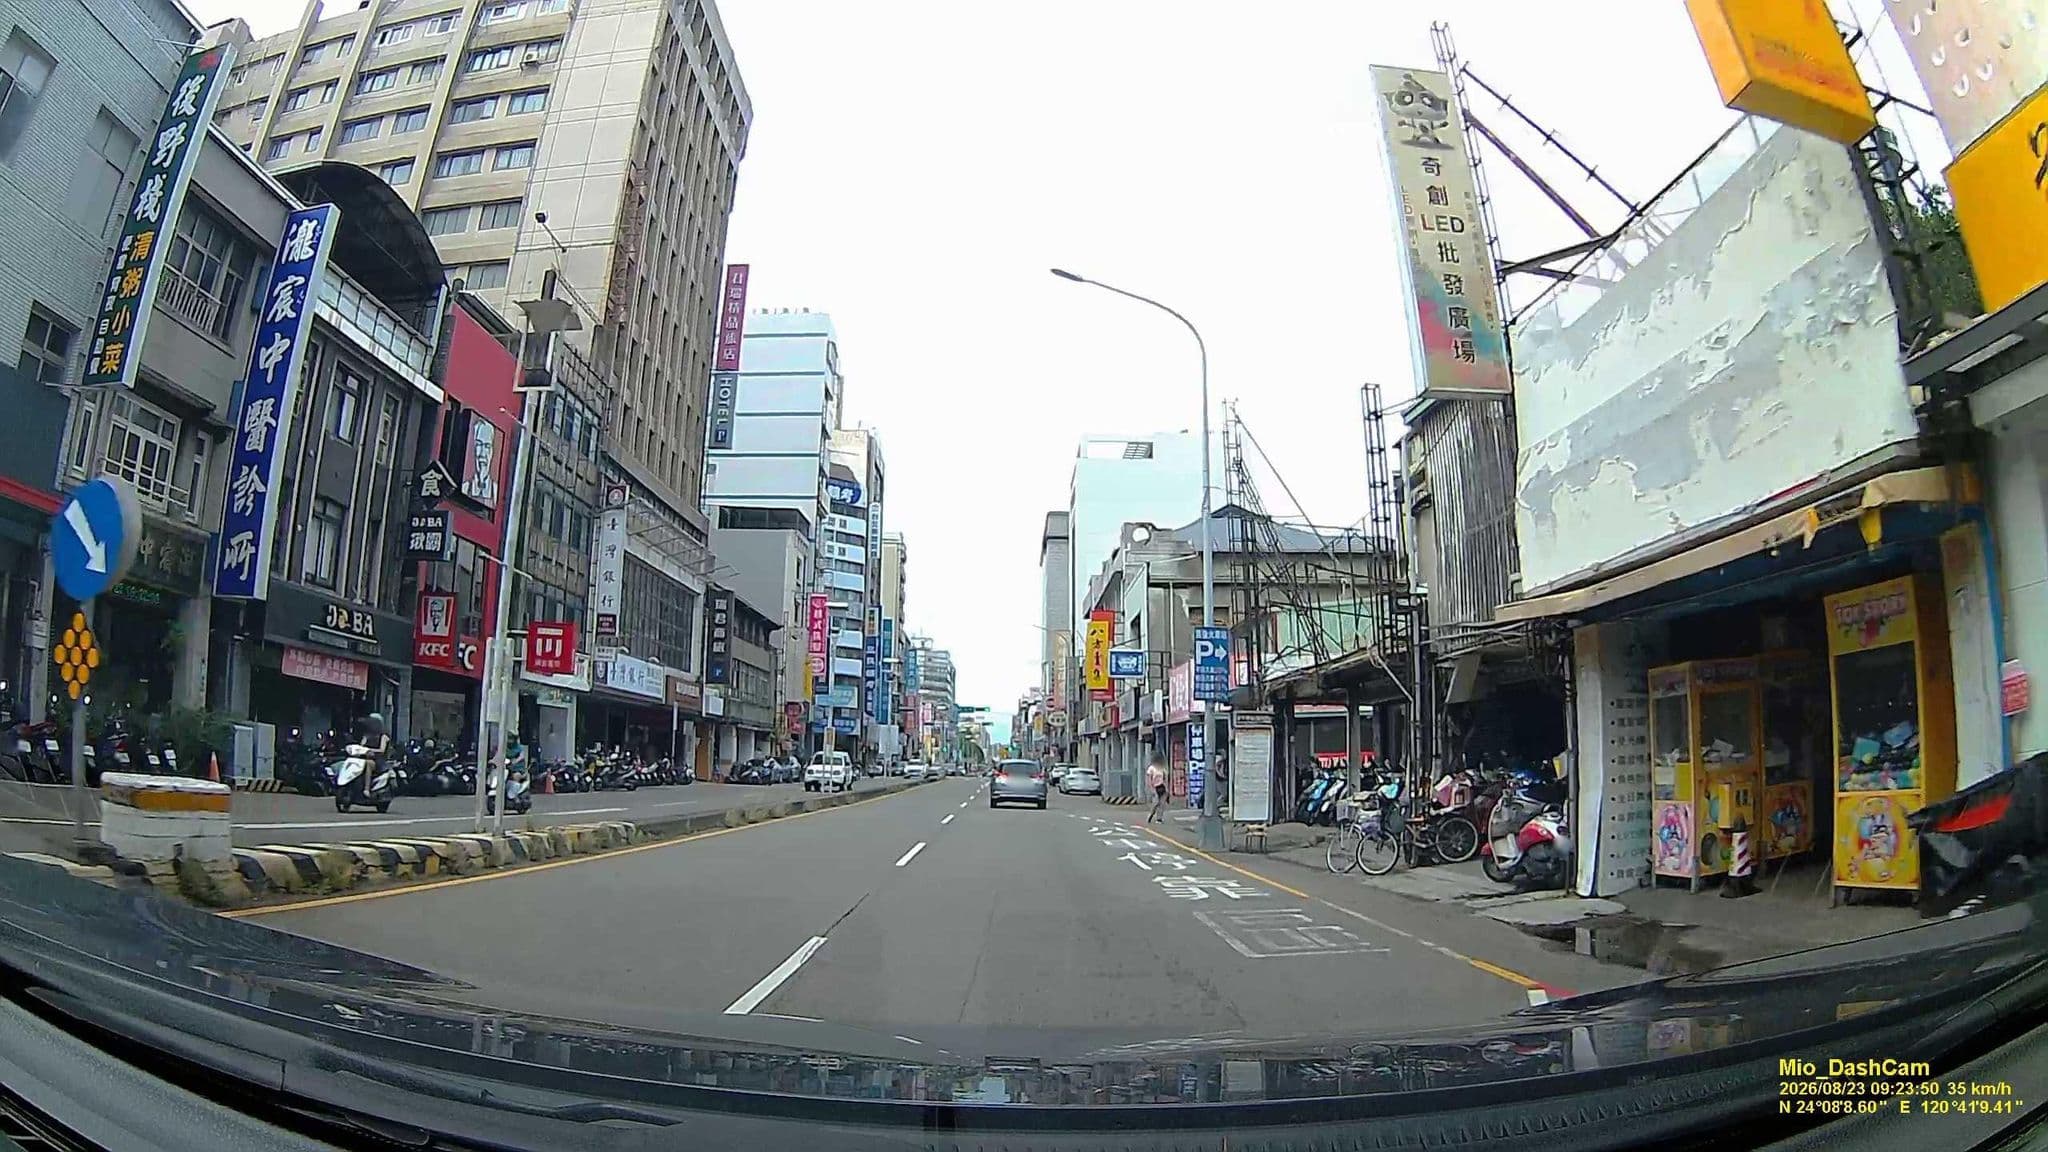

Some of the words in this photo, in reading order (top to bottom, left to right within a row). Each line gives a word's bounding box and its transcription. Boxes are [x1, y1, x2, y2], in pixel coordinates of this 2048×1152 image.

[1421, 156, 1475, 363] 奇創LED批發廣場
[101, 230, 155, 375] 清粥小菜
[718, 378, 732, 425] HOTEL
[420, 469, 444, 497] 食
[419, 642, 451, 657] KFC
[1196, 640, 1214, 665] P
